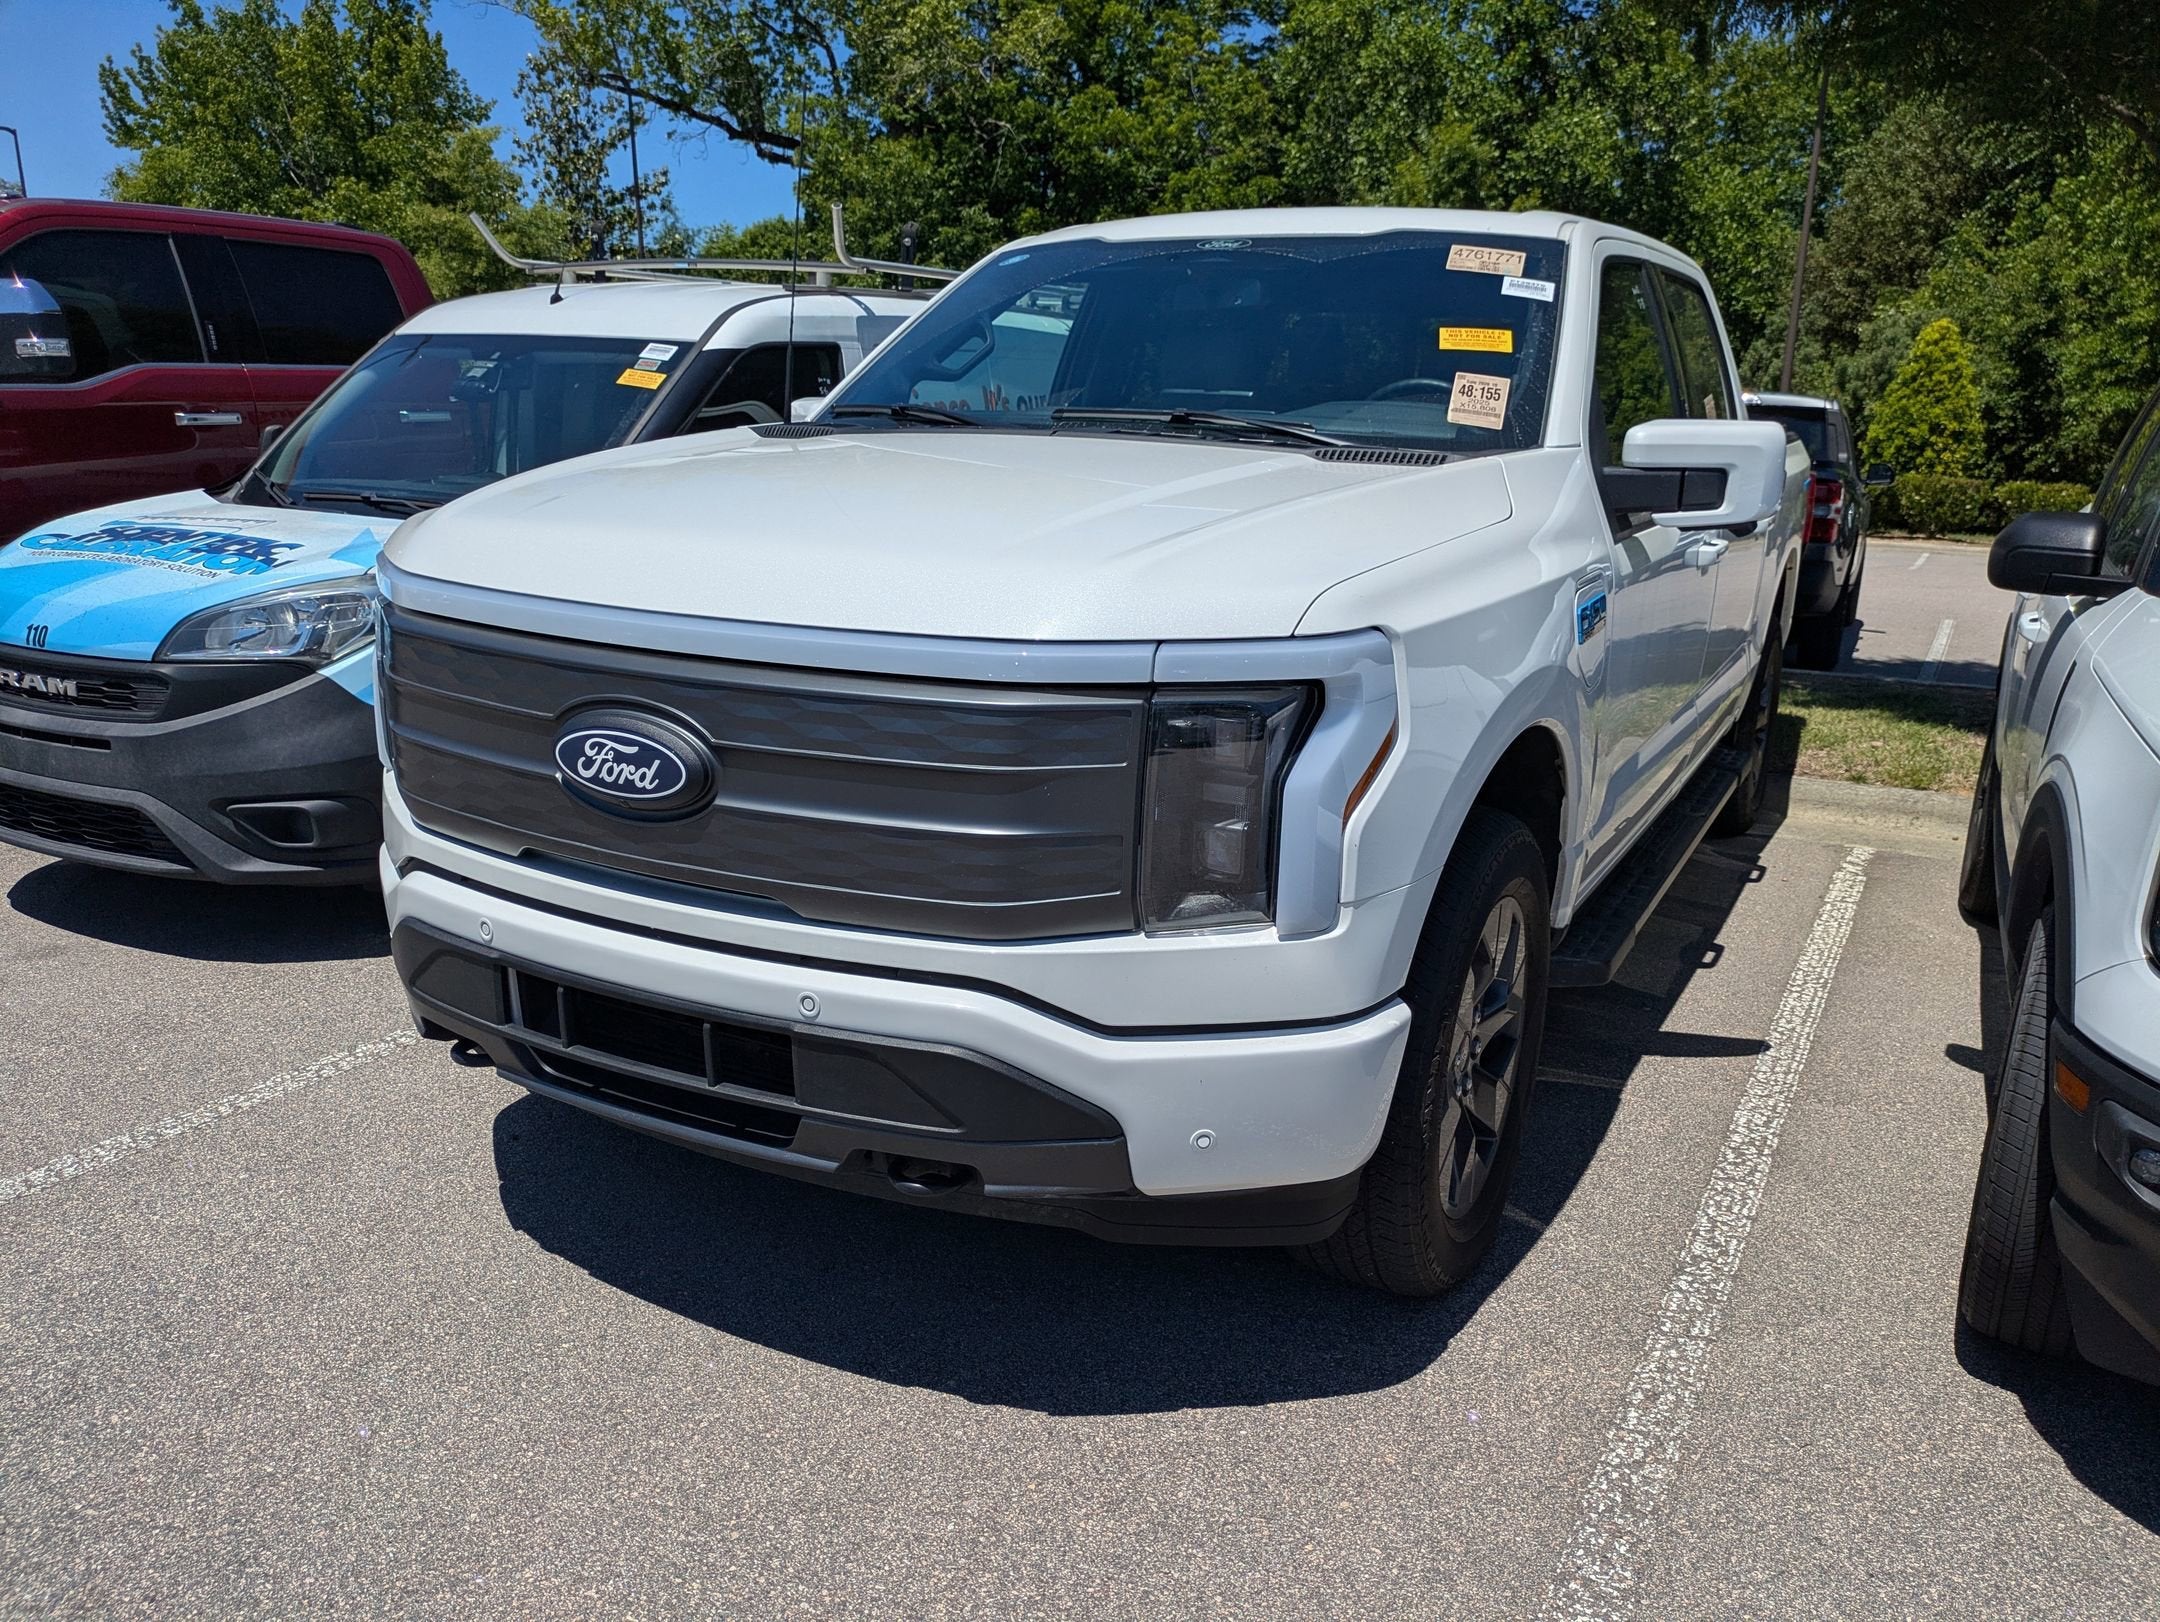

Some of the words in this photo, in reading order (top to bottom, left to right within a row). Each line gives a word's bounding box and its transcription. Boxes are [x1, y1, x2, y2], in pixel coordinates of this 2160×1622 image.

[1453, 248, 1523, 265] 4761771
[1458, 384, 1502, 402] 48:155
[1468, 398, 1490, 406] 2025
[98, 554, 167, 569] LABORATORY
[162, 563, 222, 579] SOLUTION
[26, 624, 49, 648] 110
[0, 668, 78, 698] RAM
[577, 737, 661, 790] Ford
